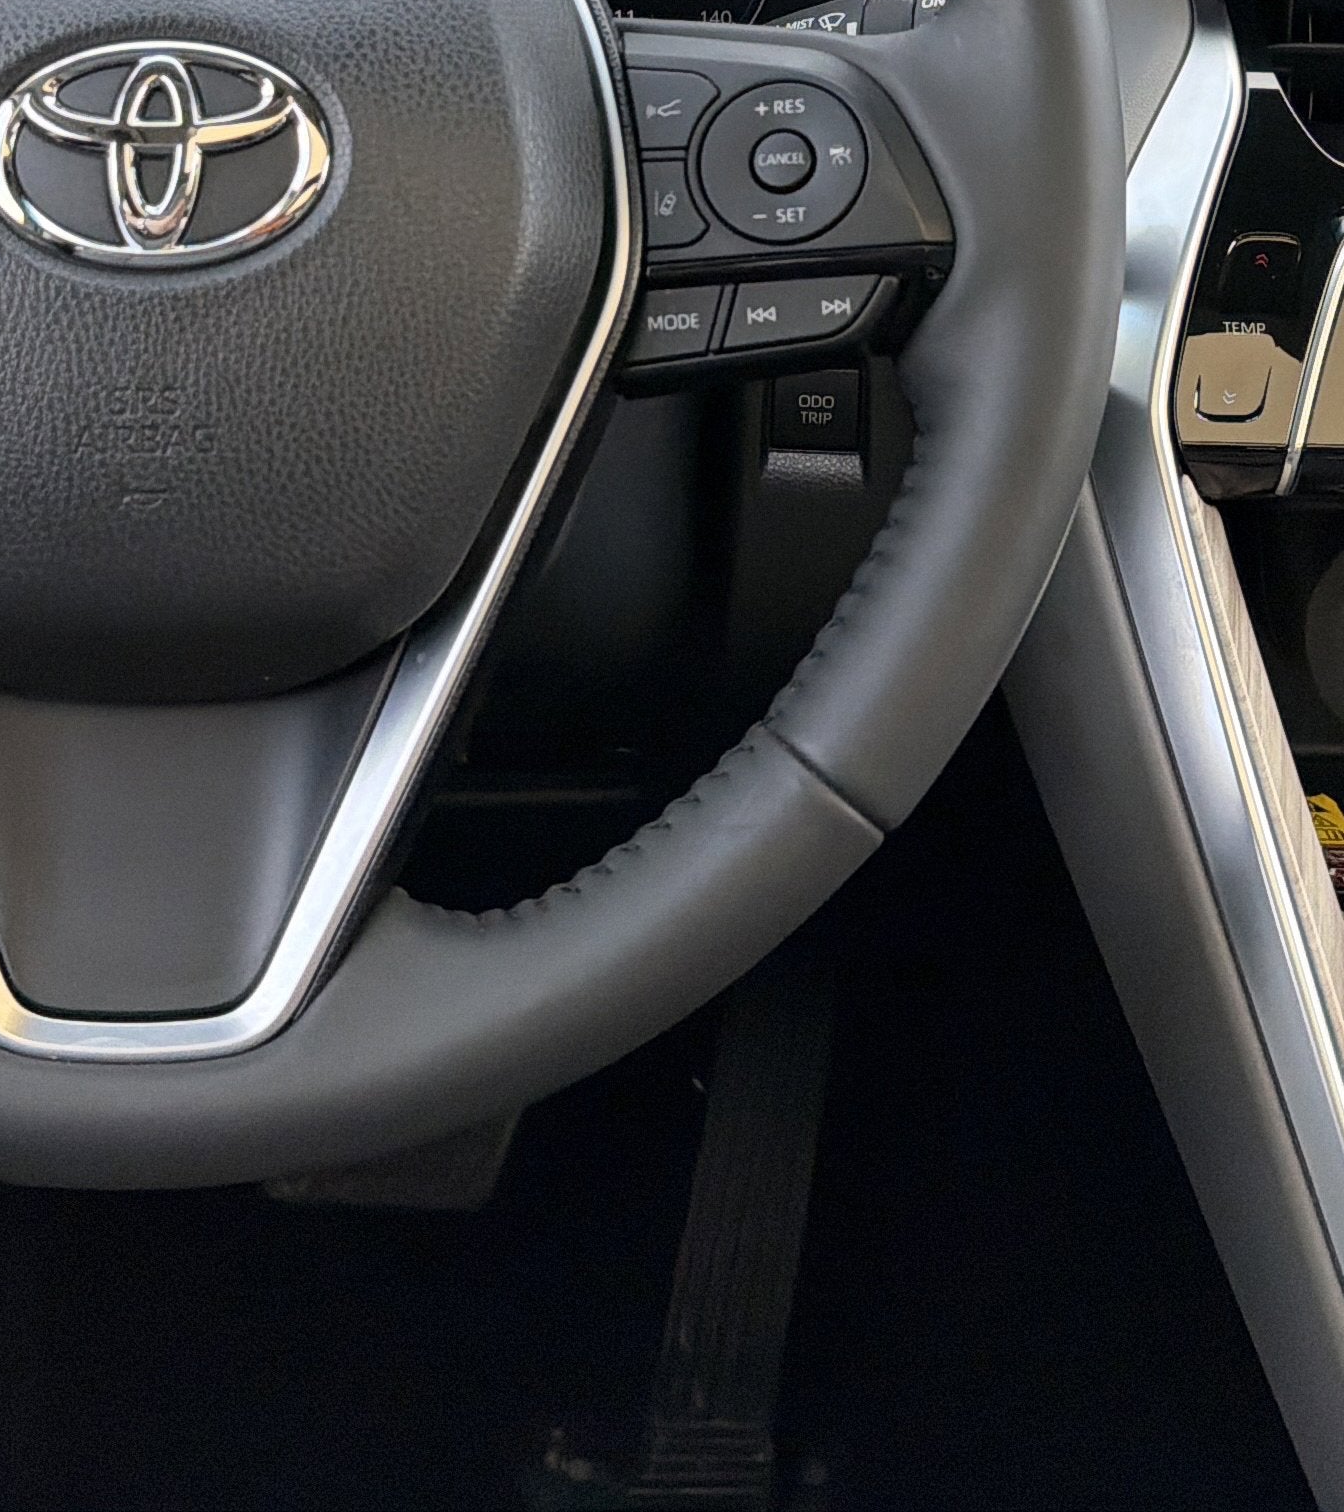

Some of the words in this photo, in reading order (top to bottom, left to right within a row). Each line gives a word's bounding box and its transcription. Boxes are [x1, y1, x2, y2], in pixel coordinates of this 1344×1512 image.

[700, 10, 732, 23] 140
[786, 17, 815, 30] MIST
[773, 98, 806, 114] RES
[757, 151, 806, 167] CANCEL
[775, 207, 807, 224] SET
[647, 312, 700, 331] MODE
[1222, 320, 1266, 336] TEMP
[798, 394, 835, 409] ODO
[800, 410, 832, 425] TRIP
